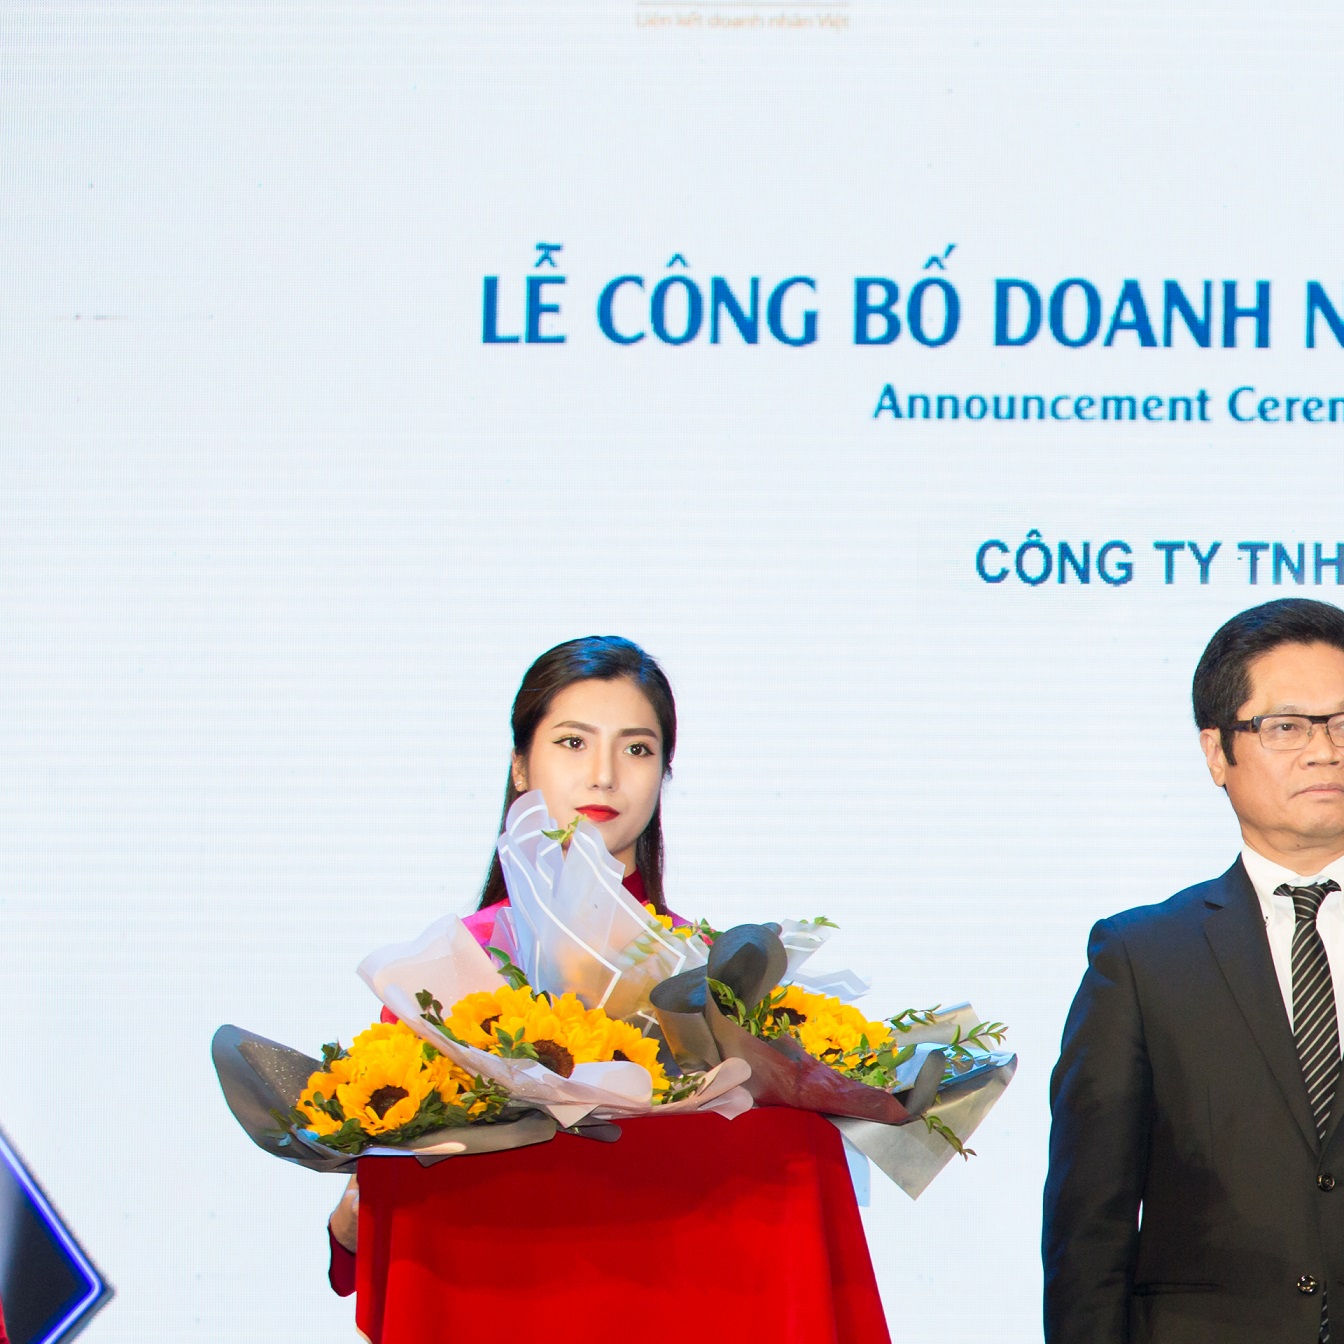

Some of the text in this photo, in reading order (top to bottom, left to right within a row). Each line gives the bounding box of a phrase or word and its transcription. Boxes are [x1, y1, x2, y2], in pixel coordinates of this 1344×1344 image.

[481, 241, 567, 344] LỄ
[596, 253, 819, 347] CÔNG
[853, 243, 961, 349] BỐ
[993, 277, 1271, 349] DOANH
[872, 383, 1211, 422] Announcement
[975, 528, 1133, 587] CÔNG
[1153, 540, 1222, 584] TY
